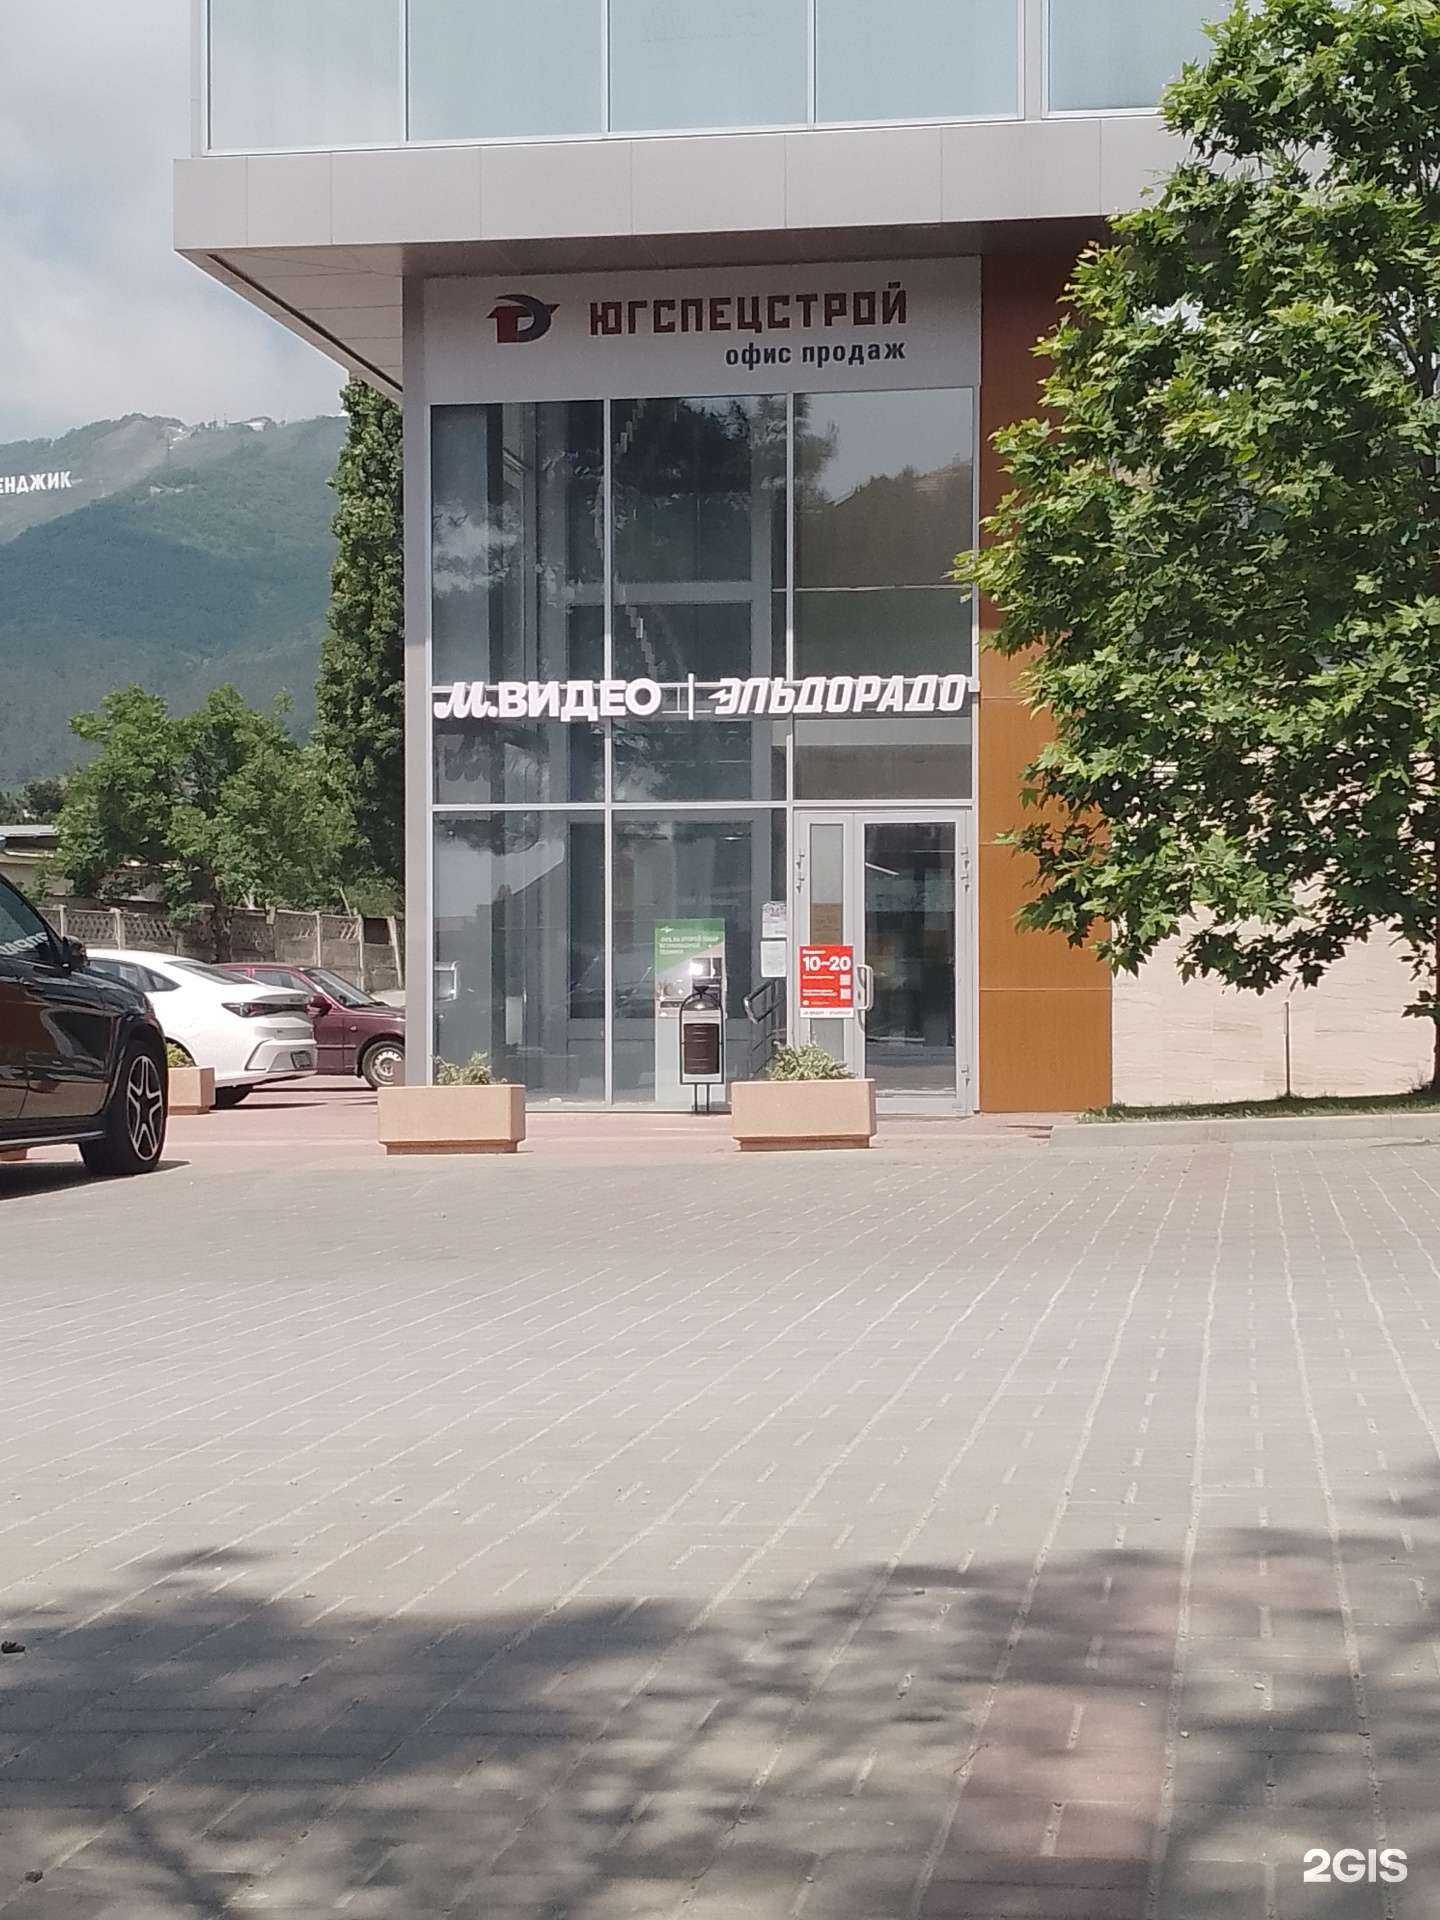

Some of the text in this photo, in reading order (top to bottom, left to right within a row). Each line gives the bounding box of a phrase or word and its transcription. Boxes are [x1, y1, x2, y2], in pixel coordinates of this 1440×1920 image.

[590, 281, 907, 336] ЮГСПЕЦСТРОЙ
[725, 339, 906, 371] офис продаж
[708, 674, 967, 716] ЭЛЬДОРАДО
[802, 955, 852, 972] 10-20
